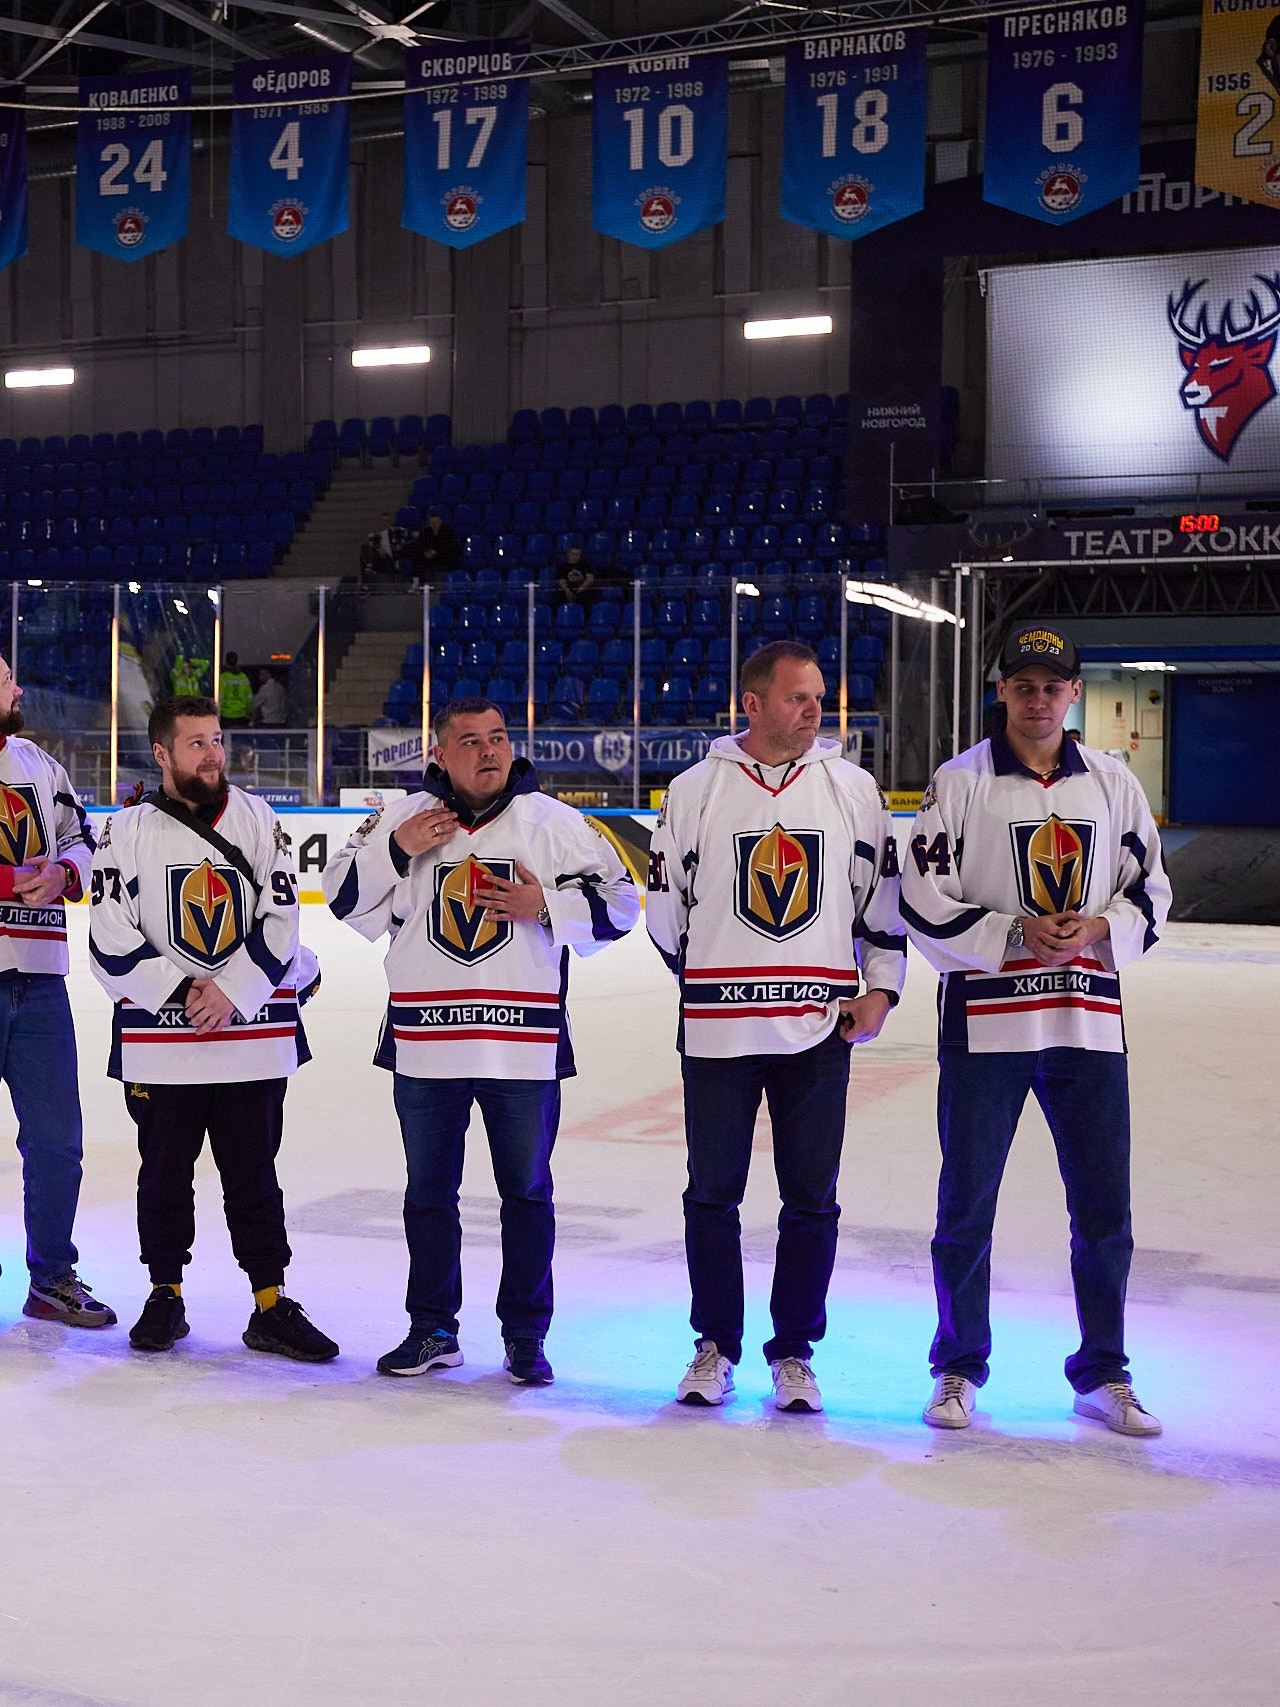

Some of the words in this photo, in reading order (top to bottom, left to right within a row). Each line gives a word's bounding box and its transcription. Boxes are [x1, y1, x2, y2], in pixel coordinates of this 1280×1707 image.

[1004, 5, 1127, 38] ПРЕСНЯКОВ
[804, 30, 906, 60] ВАРНАКОВ
[1012, 49, 1055, 69] 1976
[1075, 42, 1118, 63] 1993
[421, 52, 512, 77] СКВОРЦОВ
[810, 70, 846, 88] 1976
[864, 64, 898, 83] 1991
[252, 68, 330, 95] ФЁДОРОВ
[615, 86, 650, 104] 1972
[668, 82, 703, 99] 1988
[1207, 72, 1250, 93] 1956
[89, 85, 178, 108] КОВАЛЕНКО
[426, 88, 458, 105] 1972
[474, 84, 507, 101] 1989
[138, 113, 171, 129] 2008
[815, 88, 889, 158] 18
[1042, 82, 1083, 153] 6
[1233, 92, 1275, 158] 2
[432, 106, 498, 170] 17
[623, 104, 694, 170] 10
[269, 122, 304, 180] 4
[99, 139, 167, 197] 24
[867, 402, 921, 417] НИЖНИЙ
[860, 416, 927, 430] НОВГОРОД
[1179, 514, 1220, 533] 15:00
[1064, 529, 1174, 556] ТЕАТР
[1183, 525, 1280, 554] ХОКК
[1020, 645, 1031, 653] 20
[1049, 646, 1060, 655] 23
[911, 832, 951, 877] 64
[91, 868, 122, 907] 97
[6, 908, 63, 925] ЛЕГИОН
[720, 985, 747, 1001] ХК
[751, 984, 830, 1001] ЛЕГИОН
[1013, 977, 1040, 995] ХК
[157, 1010, 185, 1026] ХК
[420, 1009, 444, 1024] ХК
[448, 1007, 525, 1025] ЛЕГИОН
